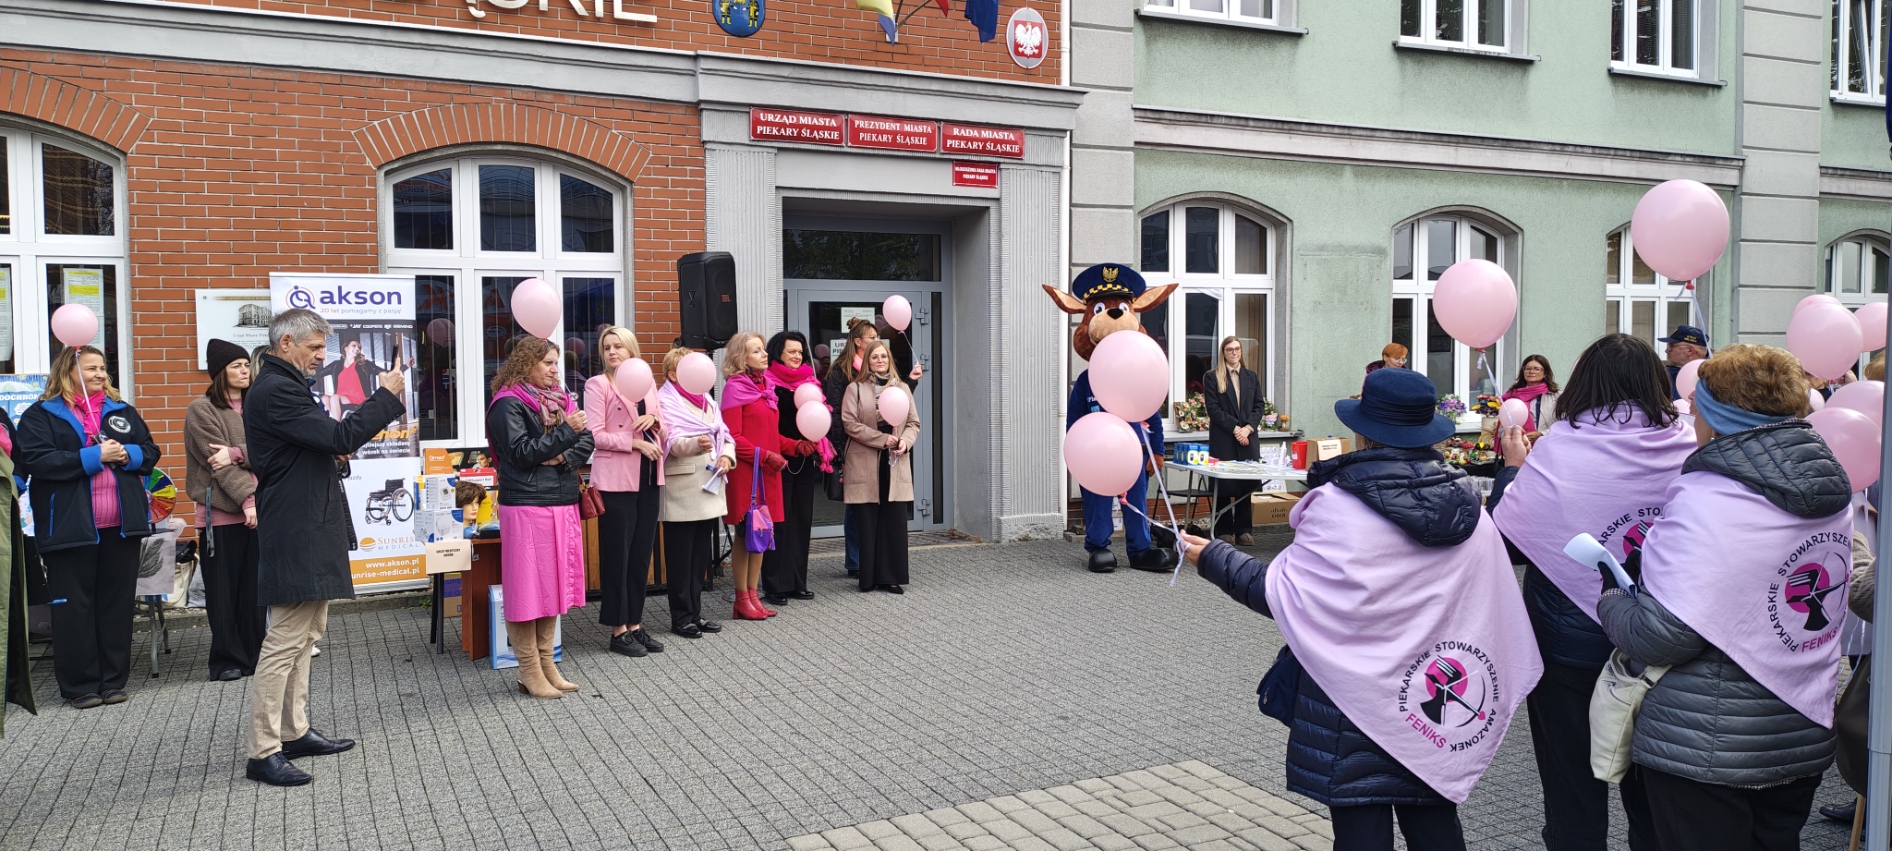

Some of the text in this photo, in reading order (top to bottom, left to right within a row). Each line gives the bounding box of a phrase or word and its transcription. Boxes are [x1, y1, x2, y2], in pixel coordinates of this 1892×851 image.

[760, 112, 837, 127] URZĄD MIASTA
[854, 119, 933, 134] PREZYDENT MIASTA
[756, 125, 840, 141] PIEKARY ŚLĄSKIE
[859, 132, 928, 146] PIEKARY ŚLĄSKIE
[953, 127, 1016, 141] RADA MIASTA
[946, 139, 1020, 153] PIEKARY ŚLĄSKIE
[320, 285, 402, 305] akson
[383, 307, 402, 315] pasją!
[1598, 513, 1632, 547] ARSKIE
[378, 536, 414, 545] SUNRIS
[365, 557, 420, 568] www.akson.pl
[351, 567, 420, 579] unrise-medical.pl
[1767, 583, 1799, 652] PIEKARSKIE
[1801, 627, 1838, 653] FENIKS
[1435, 641, 1499, 703] STOWARZYSZENIE
[1398, 650, 1431, 712] PIEKARSKIE
[1405, 713, 1447, 748] FENIKS
[1450, 708, 1497, 752] AMAZONEK
